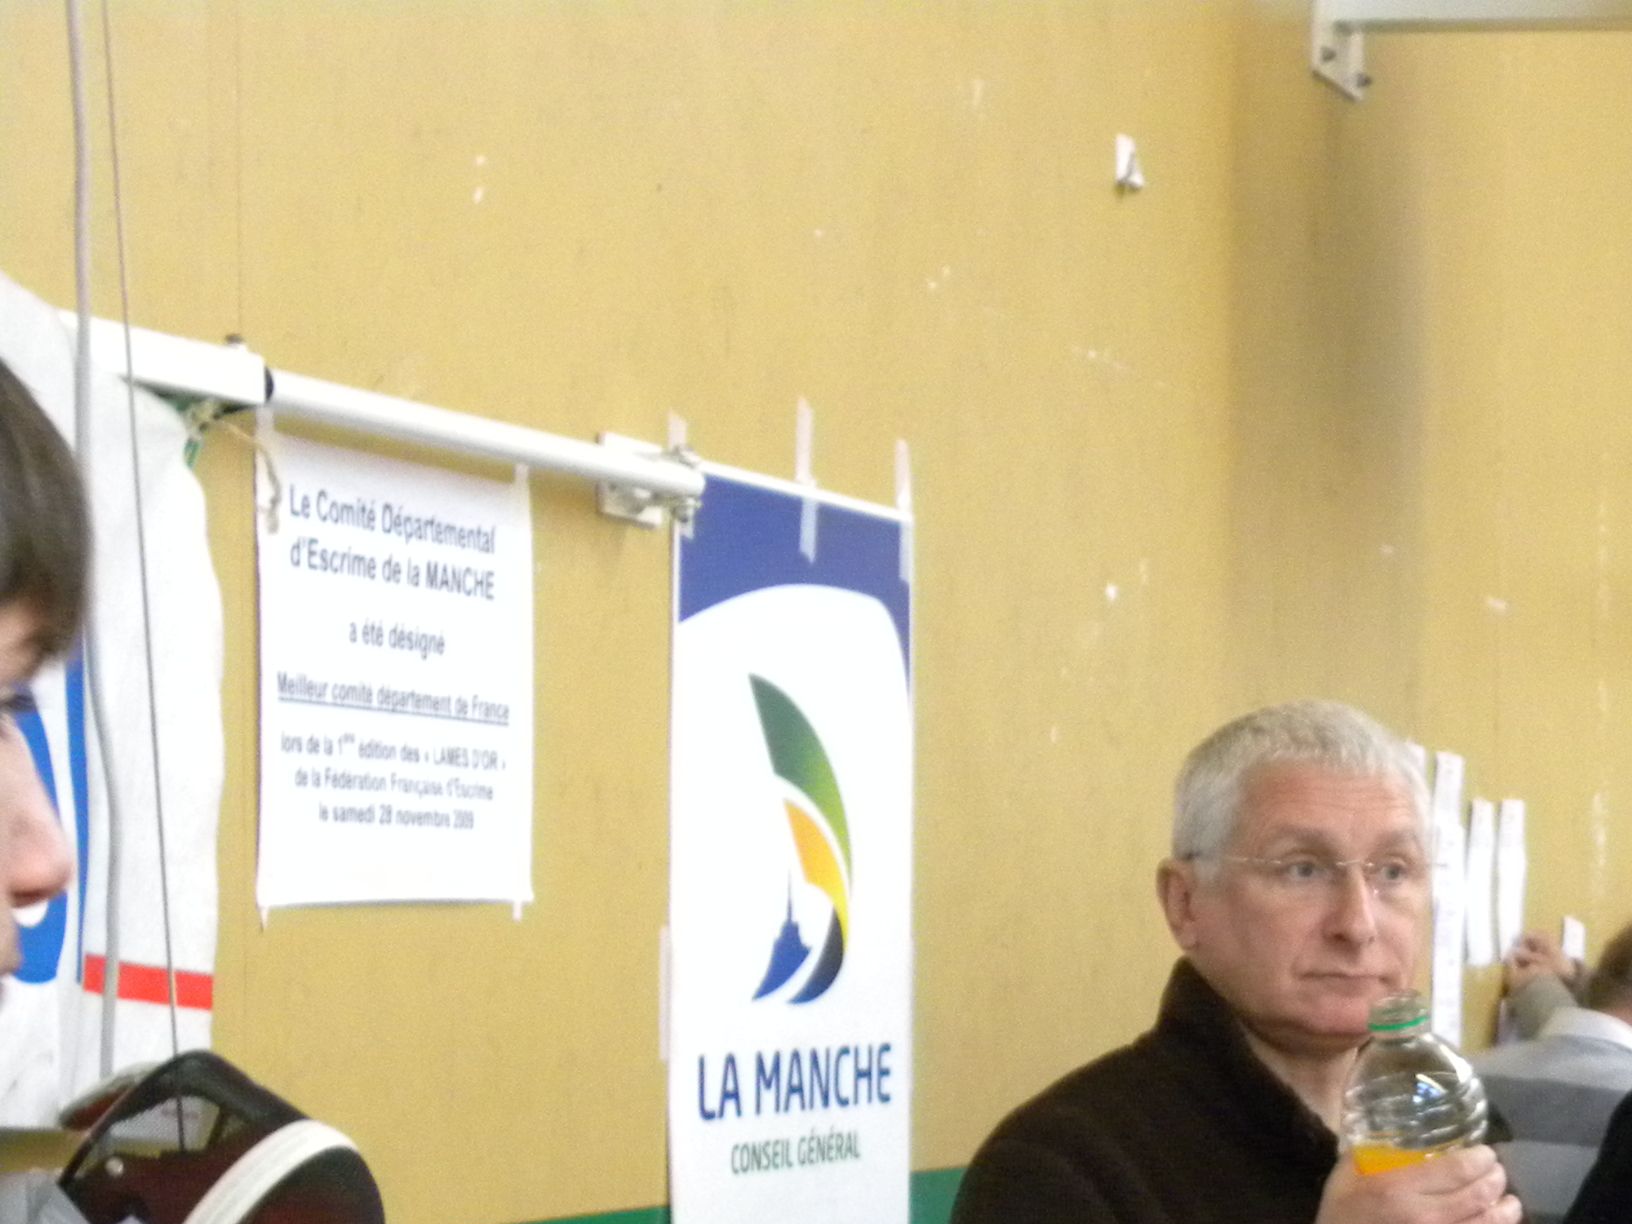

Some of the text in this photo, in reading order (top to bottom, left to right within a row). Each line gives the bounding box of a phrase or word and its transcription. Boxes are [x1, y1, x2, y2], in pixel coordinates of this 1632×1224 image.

[289, 483, 496, 554] Le Comité Départemental
[290, 535, 496, 601] d'Escrime de la MANCHE
[361, 616, 384, 647] été
[388, 621, 446, 661] désigné
[277, 670, 510, 721] Meilleur comité département de France
[281, 730, 303, 754] lors
[306, 732, 320, 755] de
[323, 733, 334, 757] la
[358, 737, 397, 761] édition
[400, 741, 420, 764] des
[294, 765, 308, 788] de
[311, 765, 321, 789] la
[324, 765, 387, 793] Fédération
[390, 772, 443, 800] Française
[318, 801, 329, 823] le
[332, 802, 376, 826] samedi
[379, 803, 393, 825] 28
[396, 808, 450, 828] novembre
[697, 1042, 892, 1121] LA MANCHE
[730, 1122, 861, 1175] CONSEIL GÉNÉRAL
